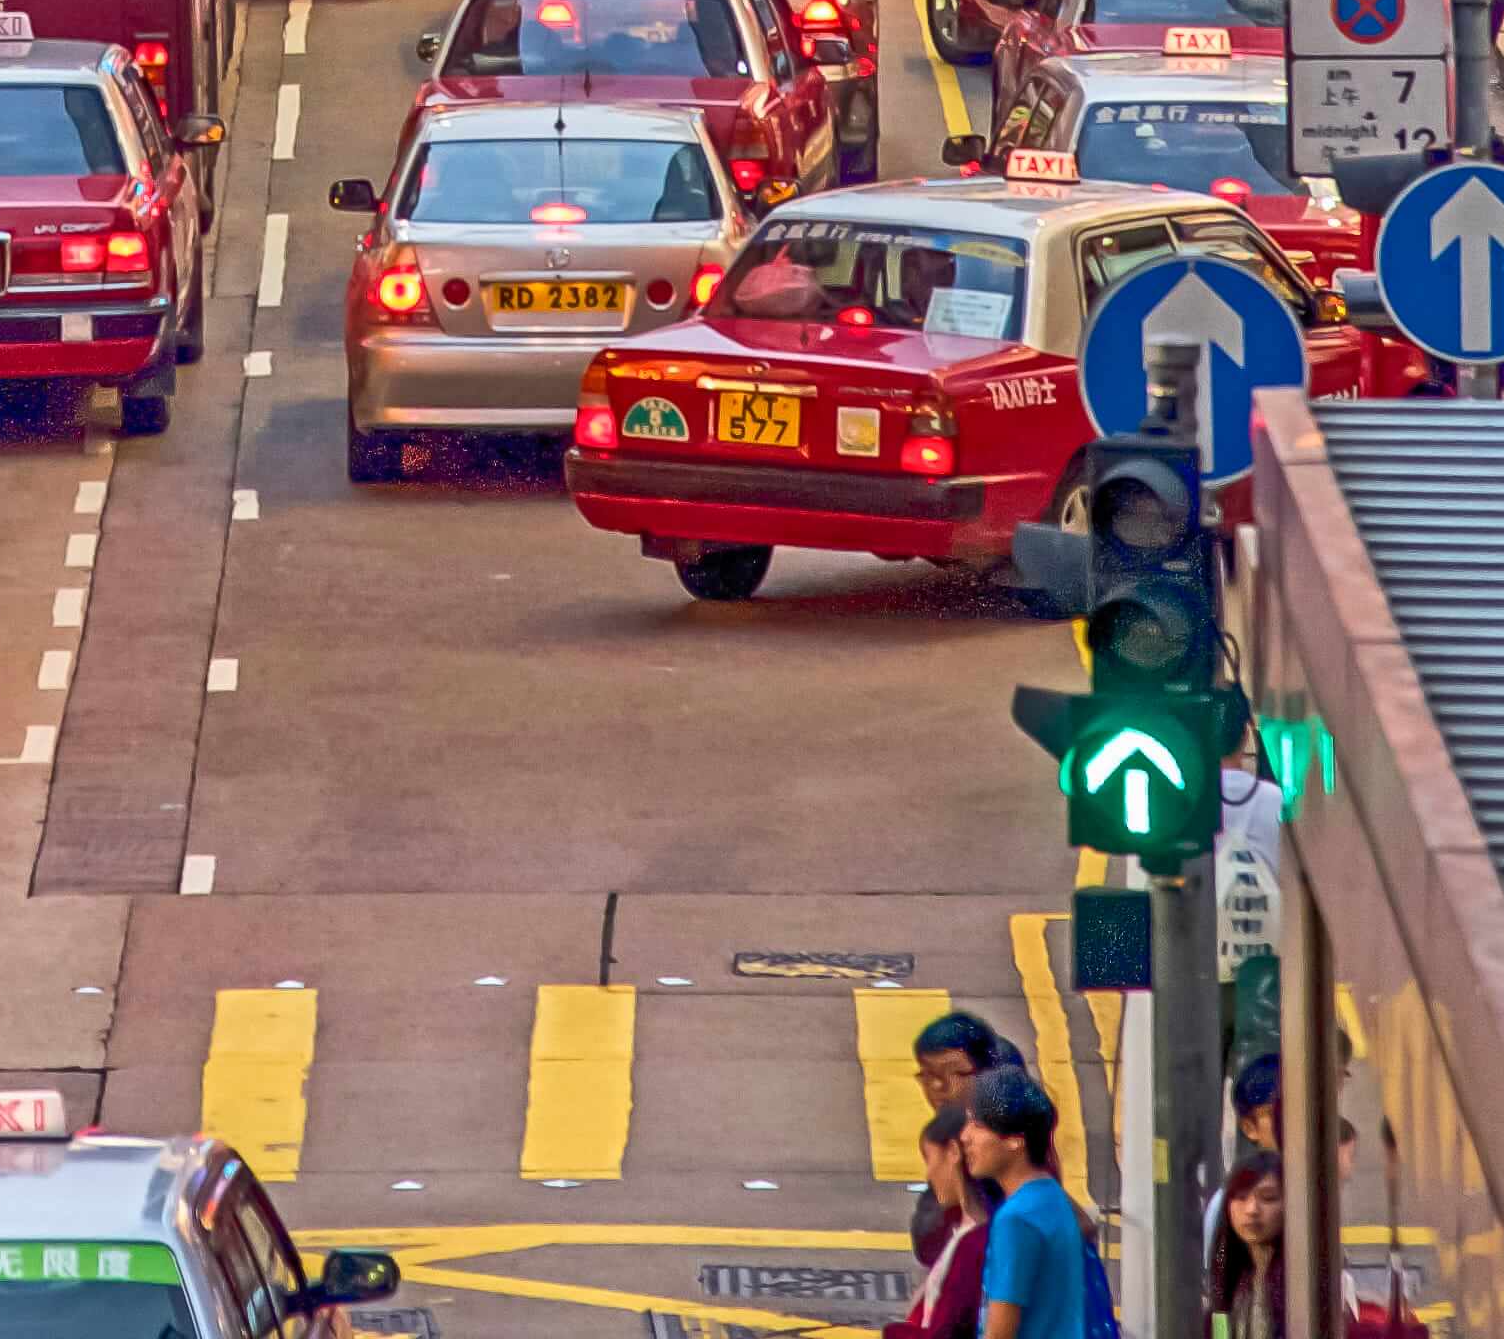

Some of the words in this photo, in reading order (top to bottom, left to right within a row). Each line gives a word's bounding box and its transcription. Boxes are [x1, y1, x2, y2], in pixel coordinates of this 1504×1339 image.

[1173, 33, 1226, 51] TAXI
[1391, 71, 1416, 104] 7
[1014, 153, 1066, 176] TAXI
[497, 284, 535, 312] RD
[548, 282, 620, 309] 2382
[741, 394, 782, 418] KT
[728, 419, 790, 442] 577
